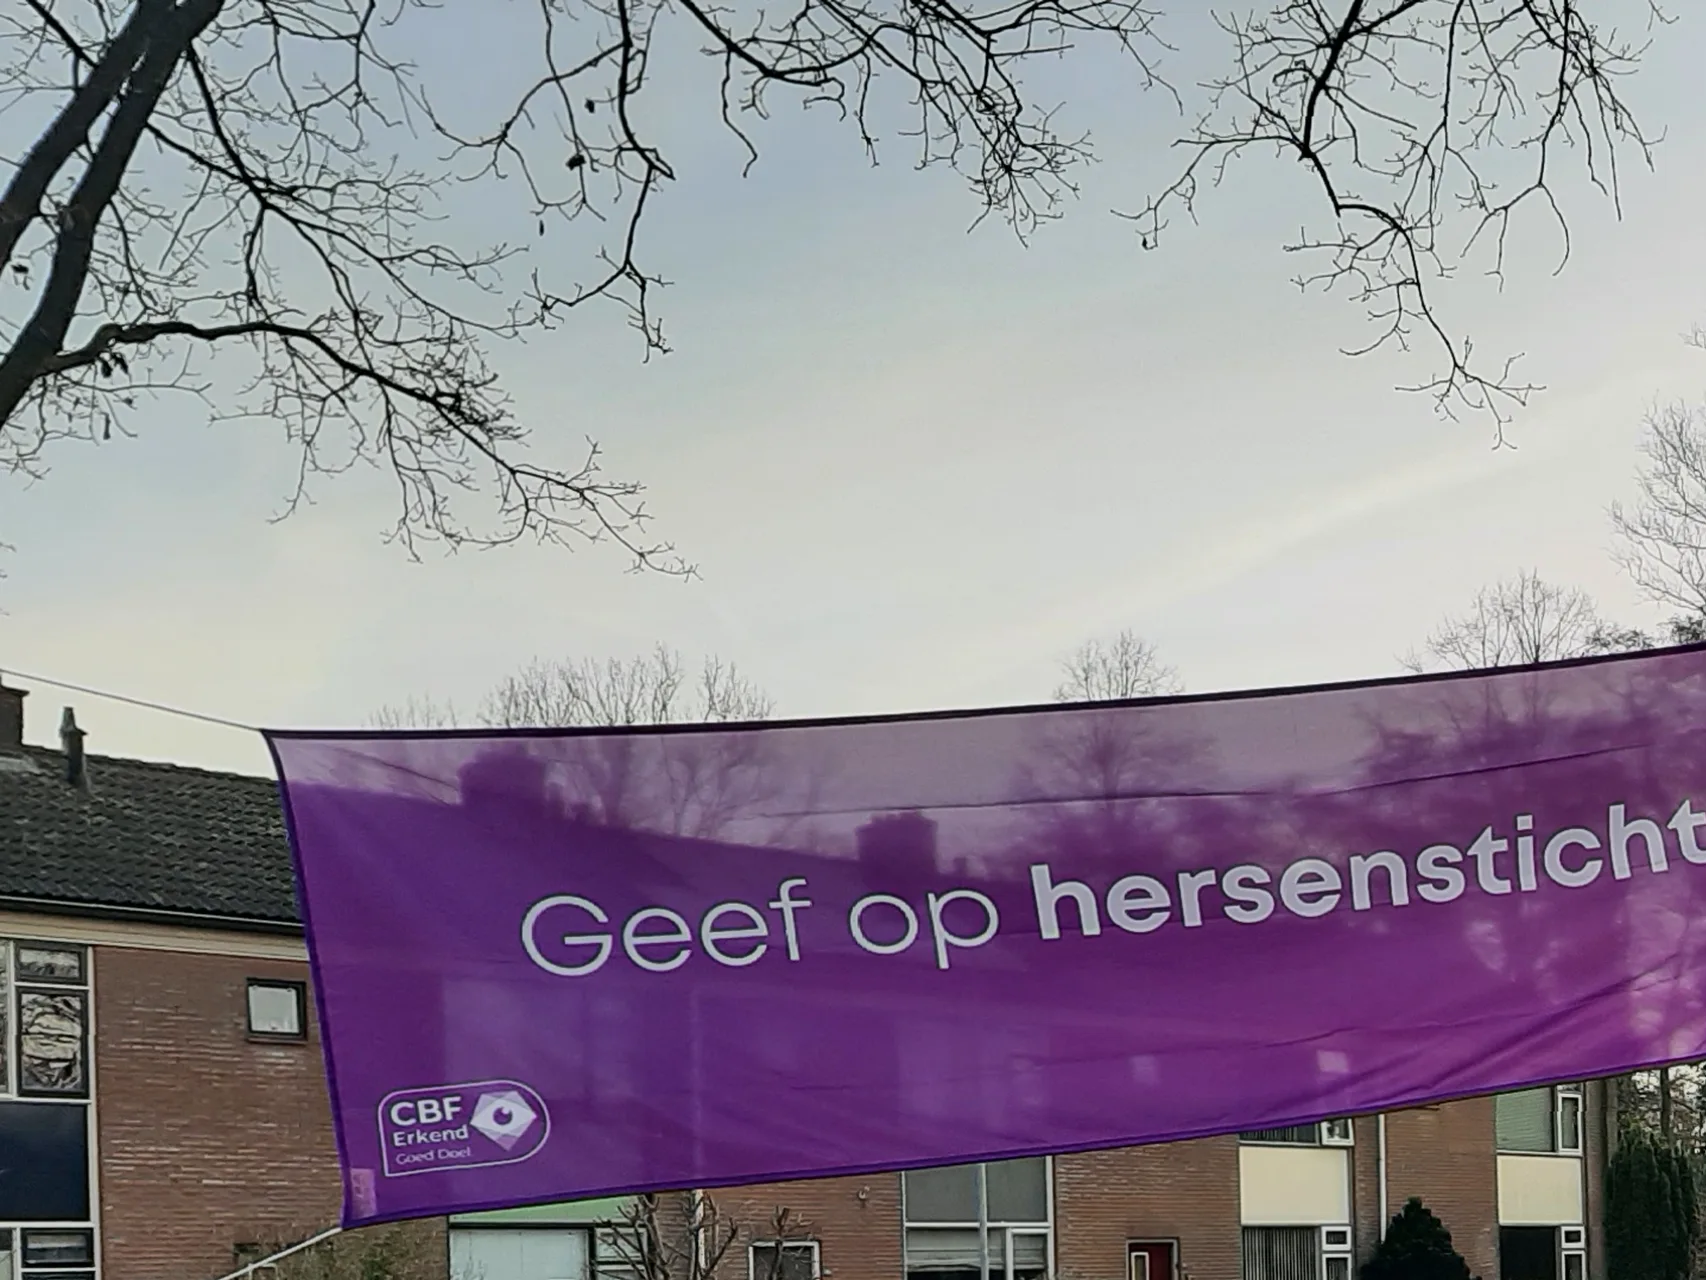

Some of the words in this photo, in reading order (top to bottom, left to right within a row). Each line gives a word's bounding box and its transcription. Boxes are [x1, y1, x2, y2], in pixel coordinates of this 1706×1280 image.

[520, 877, 813, 977] Geef
[848, 889, 1000, 970] op
[389, 1095, 462, 1127] CBF
[392, 1124, 470, 1147] Erkend
[395, 1148, 435, 1166] Goed
[437, 1146, 472, 1160] Doel
